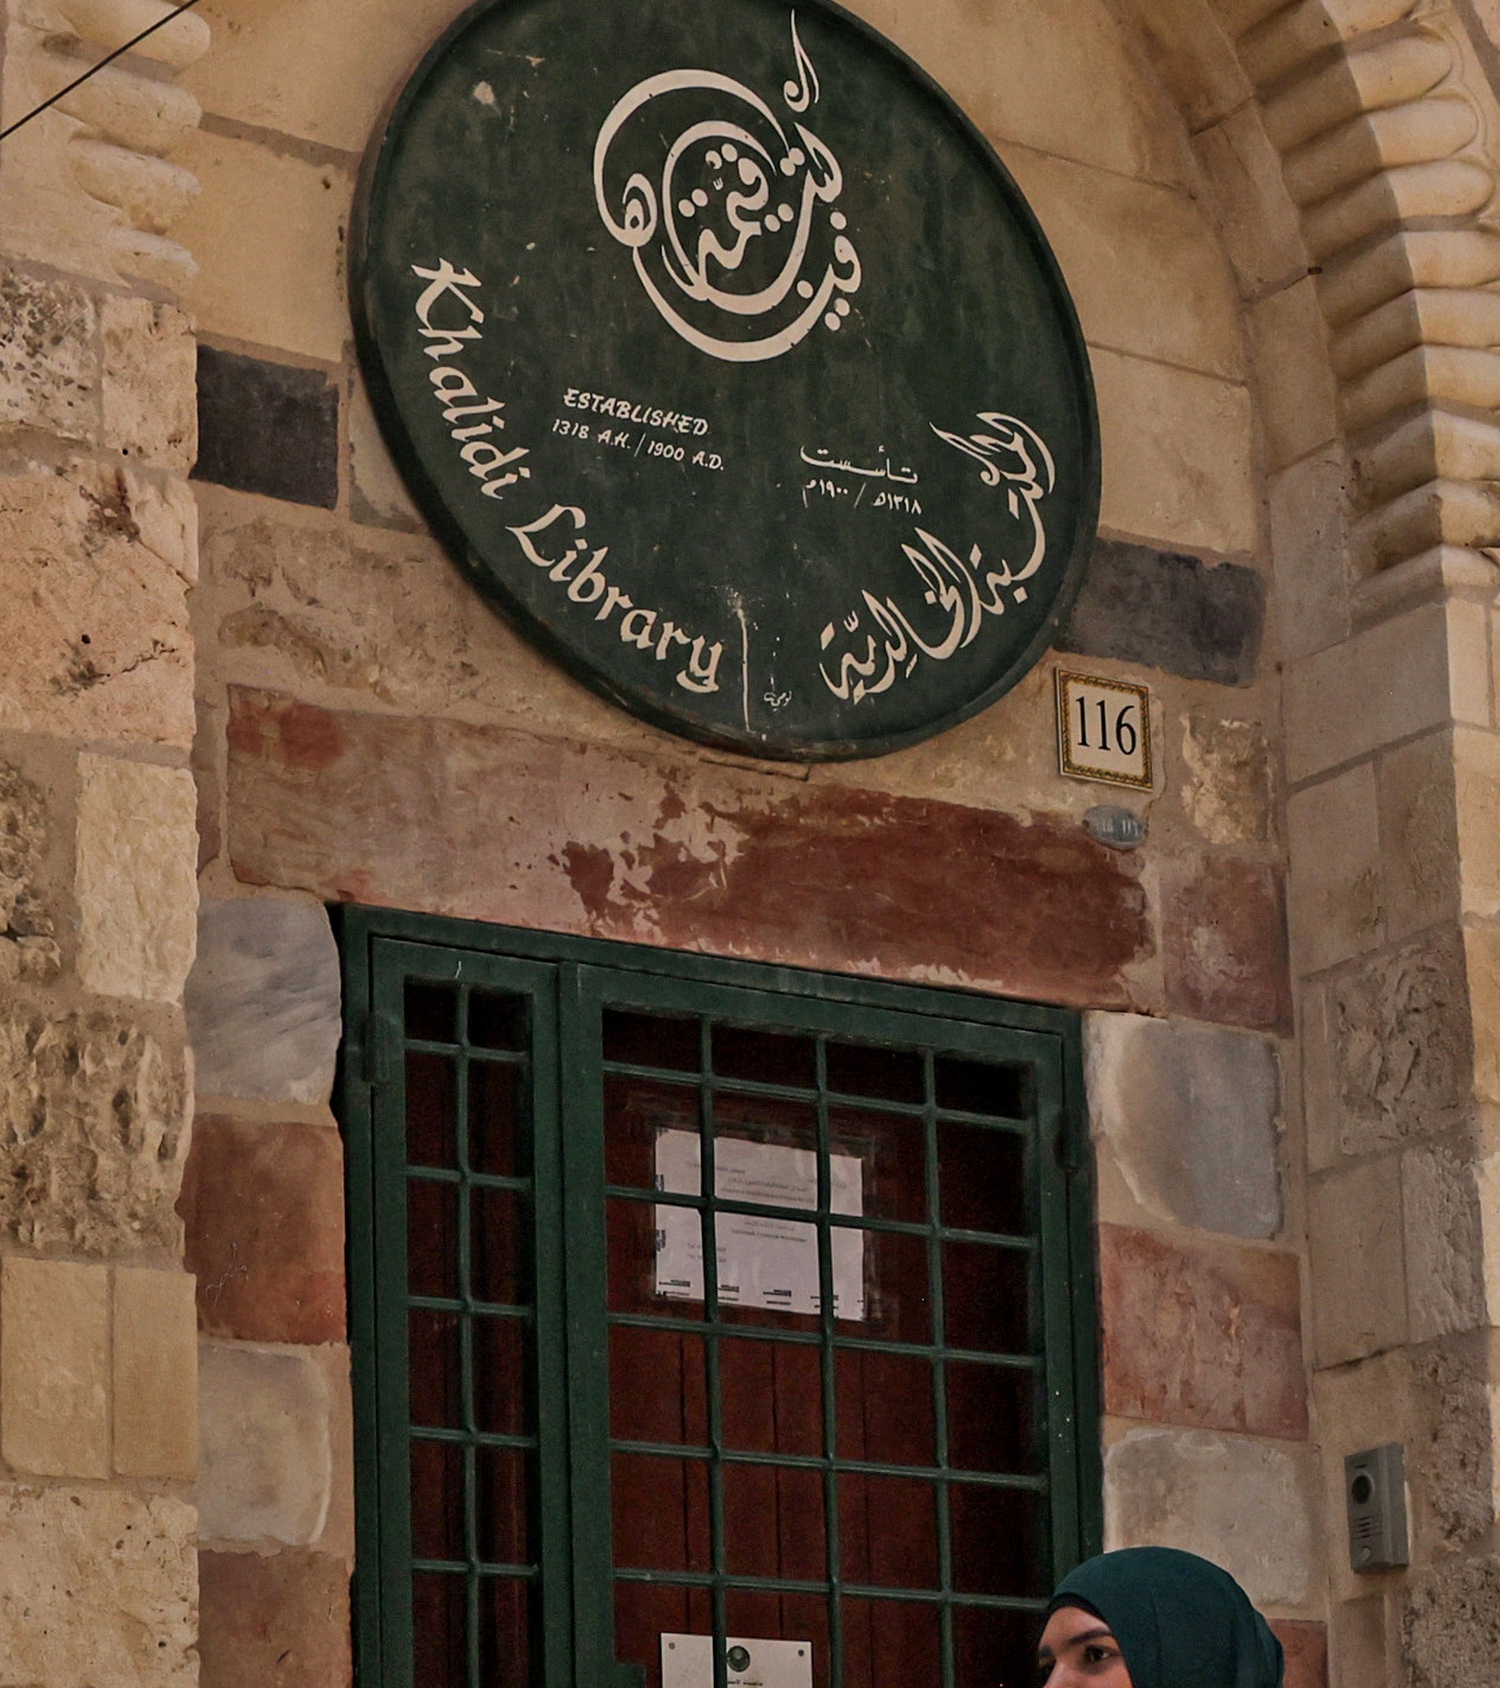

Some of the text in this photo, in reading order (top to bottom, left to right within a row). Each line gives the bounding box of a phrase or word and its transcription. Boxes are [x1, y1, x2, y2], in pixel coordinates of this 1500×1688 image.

[563, 387, 709, 436] ESTABLISHED
[552, 418, 590, 439] 1318
[598, 429, 631, 449] A.H.
[647, 440, 685, 461] 1900
[692, 450, 725, 471] A.D.
[411, 257, 724, 694] Khalidi Library
[1075, 696, 1137, 755] 116
